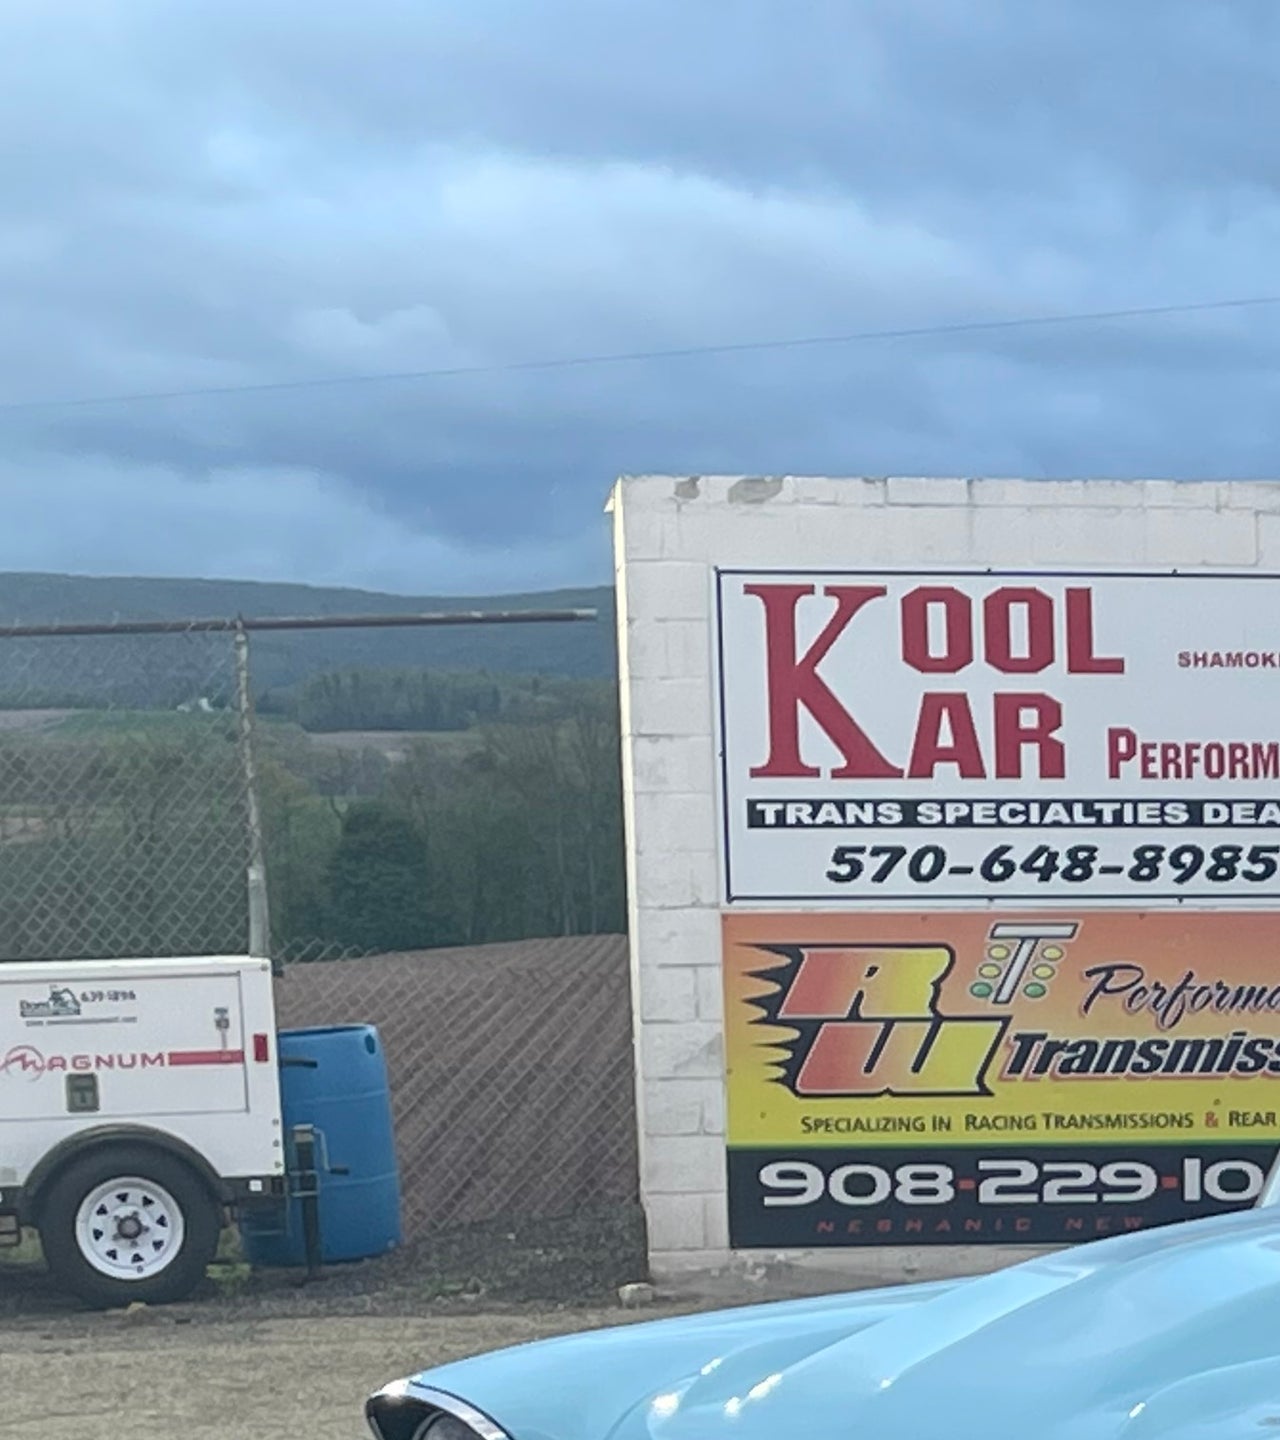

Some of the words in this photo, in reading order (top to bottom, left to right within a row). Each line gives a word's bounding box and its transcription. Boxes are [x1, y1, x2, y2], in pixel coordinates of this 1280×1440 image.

[756, 802, 903, 825] TRANS
[916, 802, 1189, 825] SPECIALTIES
[825, 843, 1280, 885] 570-648-8985
[0, 1047, 165, 1076] MAGNUM
[801, 1113, 926, 1134] SPECIALIZING
[931, 1114, 952, 1132] IN
[964, 1113, 1038, 1132] RACING
[1042, 1111, 1195, 1131] TRANSMISSIONS
[1204, 1111, 1220, 1129] &
[1227, 1110, 1278, 1128] REAR
[758, 1158, 1265, 1207] 908-229-10
